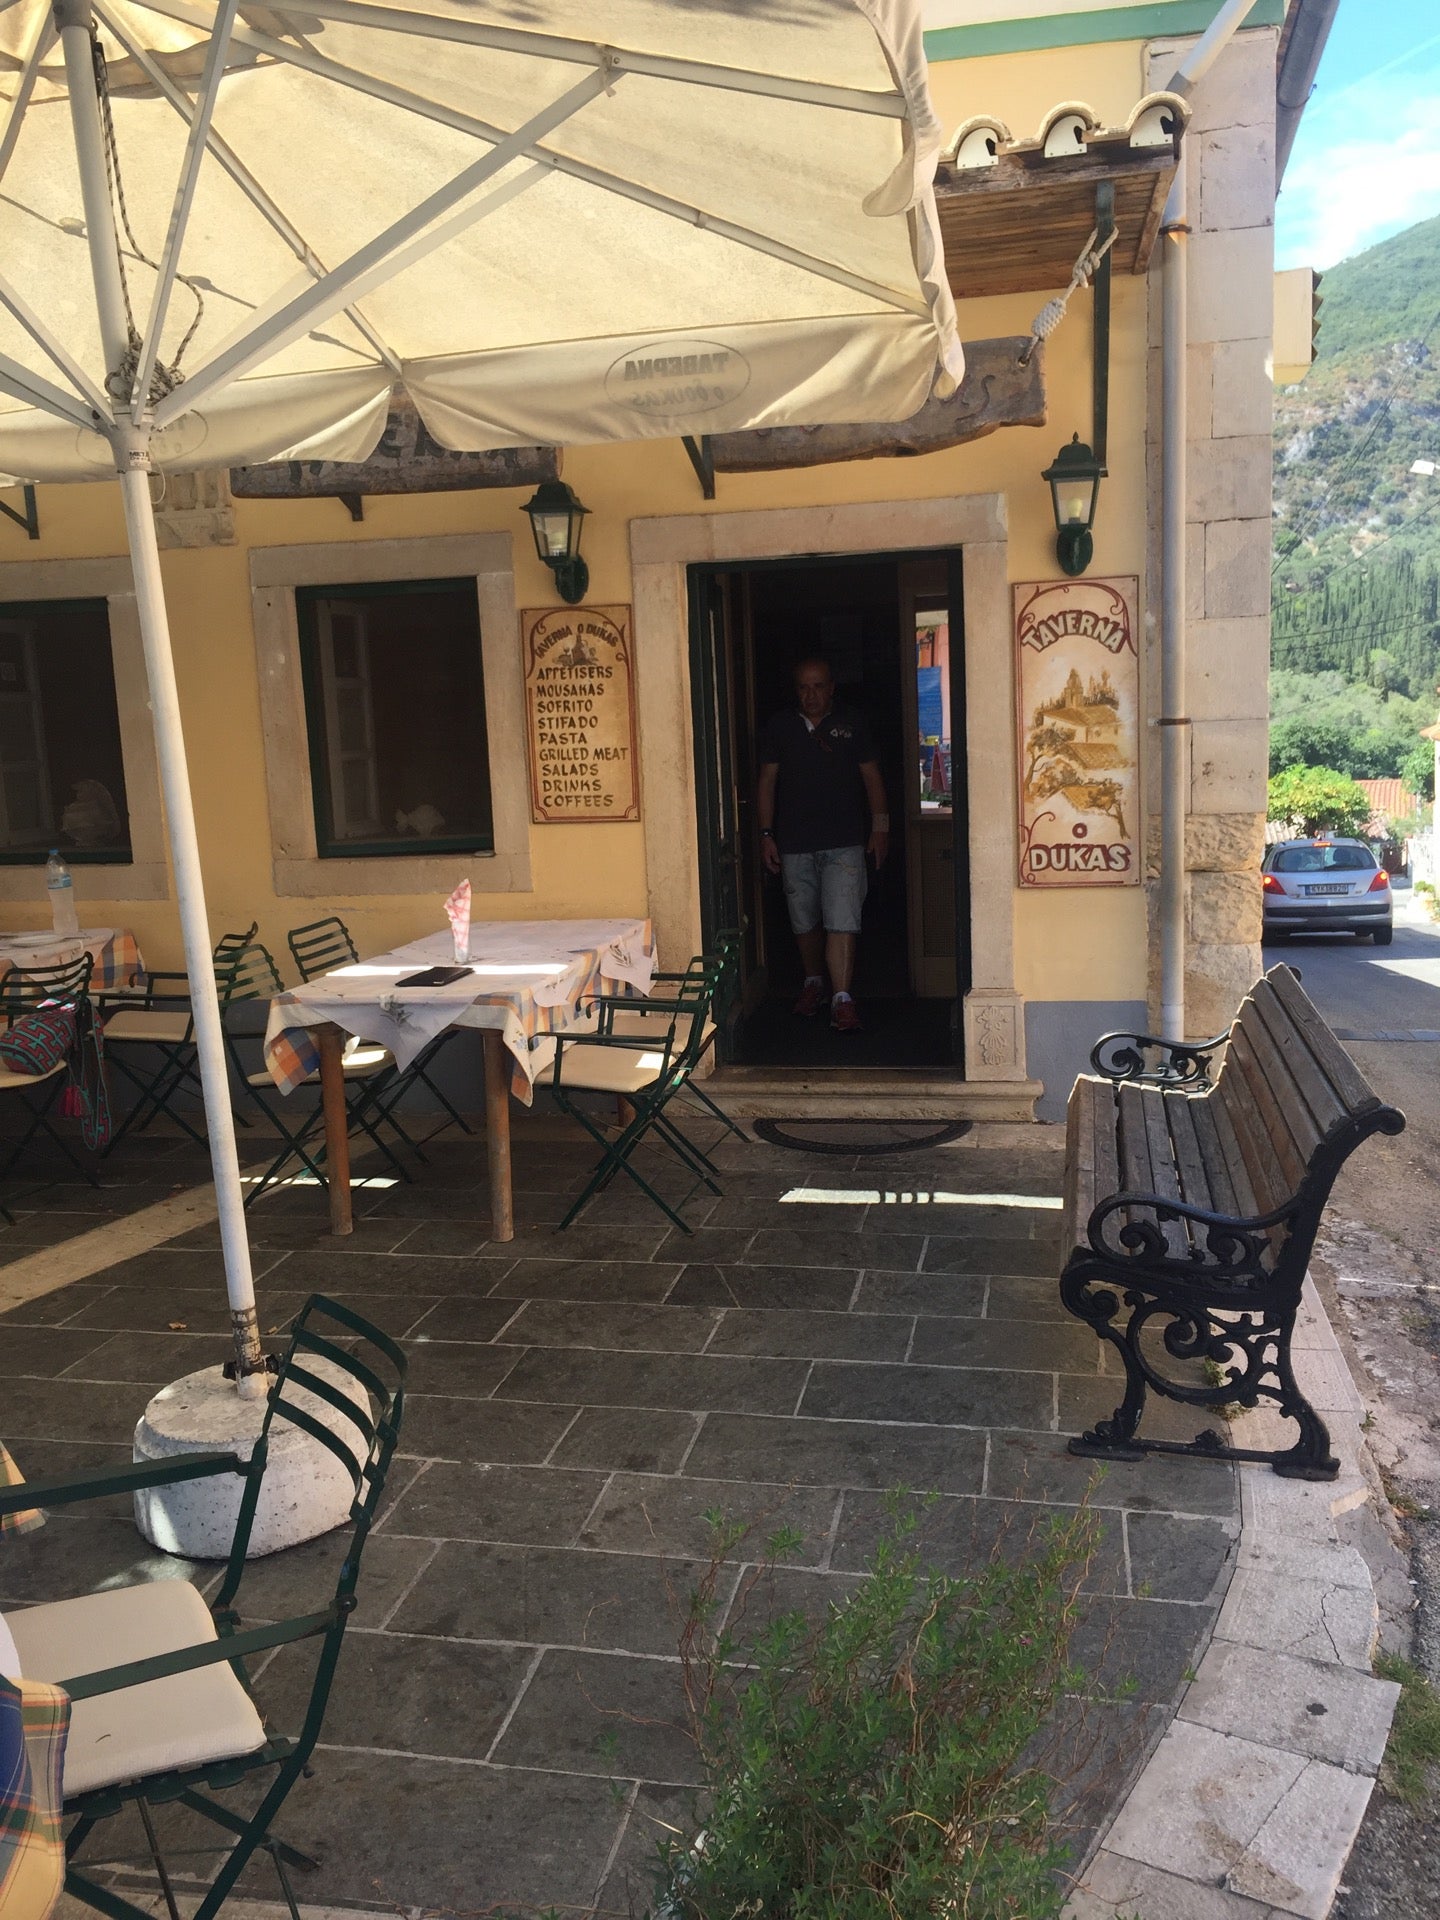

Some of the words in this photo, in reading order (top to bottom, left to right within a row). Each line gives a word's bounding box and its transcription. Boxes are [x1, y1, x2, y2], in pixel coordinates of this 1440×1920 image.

[1020, 609, 1128, 654] TAVERNA
[535, 625, 573, 659] TAVERNA
[577, 623, 584, 634] O
[586, 623, 619, 648] DUKAS
[536, 683, 605, 698] MOUSAKAS
[537, 699, 593, 713] SOFRITO
[538, 716, 598, 730] STIFADO
[539, 732, 588, 745] PASTA
[539, 748, 589, 761] GRILLED
[593, 747, 629, 761] MEAT
[542, 763, 600, 776] SALADS
[542, 779, 602, 792] DRINKS
[543, 795, 614, 807] COFFEES
[1072, 822, 1088, 838] O
[1029, 843, 1132, 872] DUKAS
